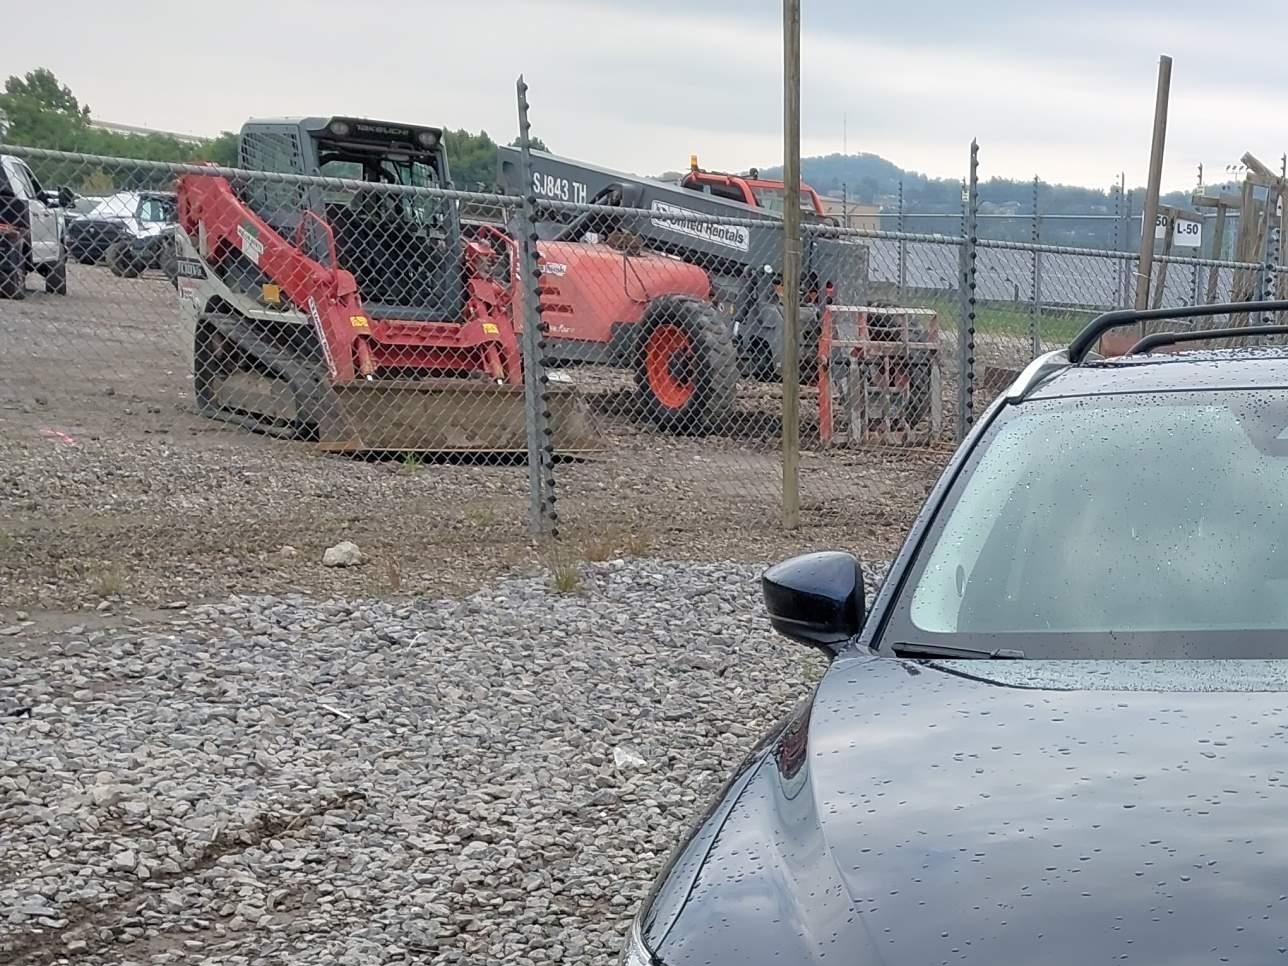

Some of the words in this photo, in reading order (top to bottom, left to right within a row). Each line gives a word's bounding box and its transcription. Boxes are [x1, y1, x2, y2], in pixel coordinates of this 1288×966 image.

[532, 171, 569, 201] SJ843
[572, 181, 587, 205] TH
[705, 223, 744, 244] Rentals
[1177, 222, 1199, 235] L-50
